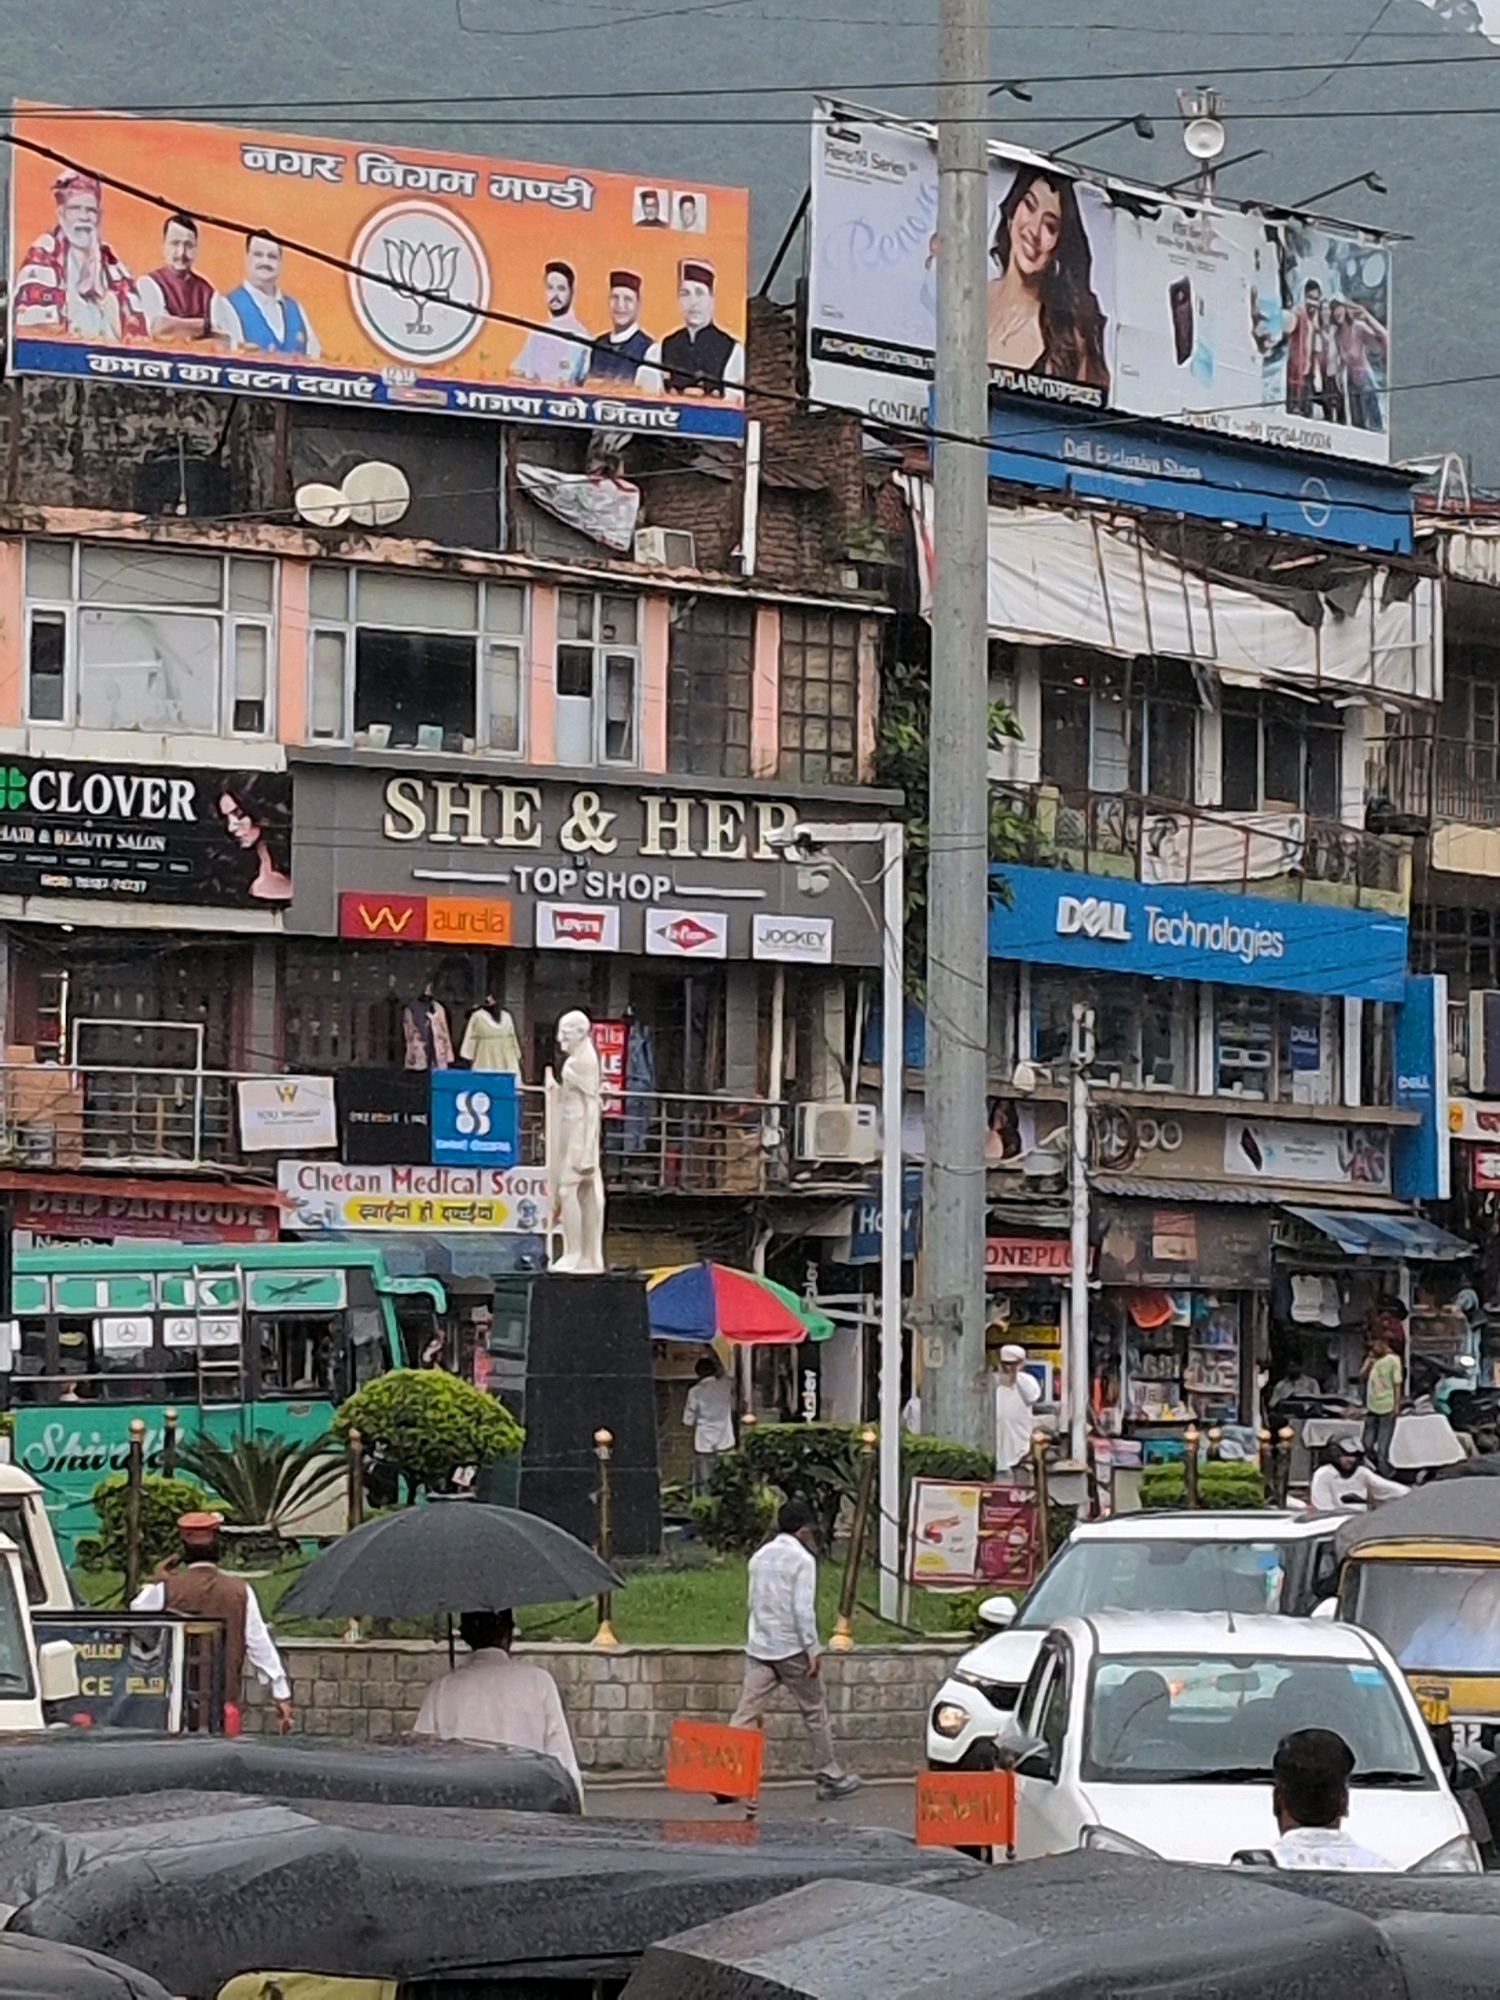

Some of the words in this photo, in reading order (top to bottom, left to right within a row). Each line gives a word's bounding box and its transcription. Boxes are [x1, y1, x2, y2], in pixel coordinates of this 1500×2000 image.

[241, 145, 345, 181] नगर
[357, 152, 478, 196] निगम
[488, 175, 594, 210] मण्डी
[87, 353, 173, 380] कमल
[178, 362, 221, 384] का
[455, 389, 543, 416] भाजपा
[547, 397, 586, 419] को
[868, 398, 930, 425] CONTAC
[29, 769, 197, 821] CLOVER
[384, 777, 543, 847] SHE
[559, 790, 618, 855] &
[638, 795, 800, 862] HER
[116, 833, 167, 852] SALON
[513, 865, 578, 896] TOP
[584, 870, 672, 902] SHOP
[758, 928, 828, 946] JOCKEY
[1056, 895, 1132, 941] DELL
[1144, 905, 1284, 965] Technologies
[297, 1166, 382, 1193] Chetan
